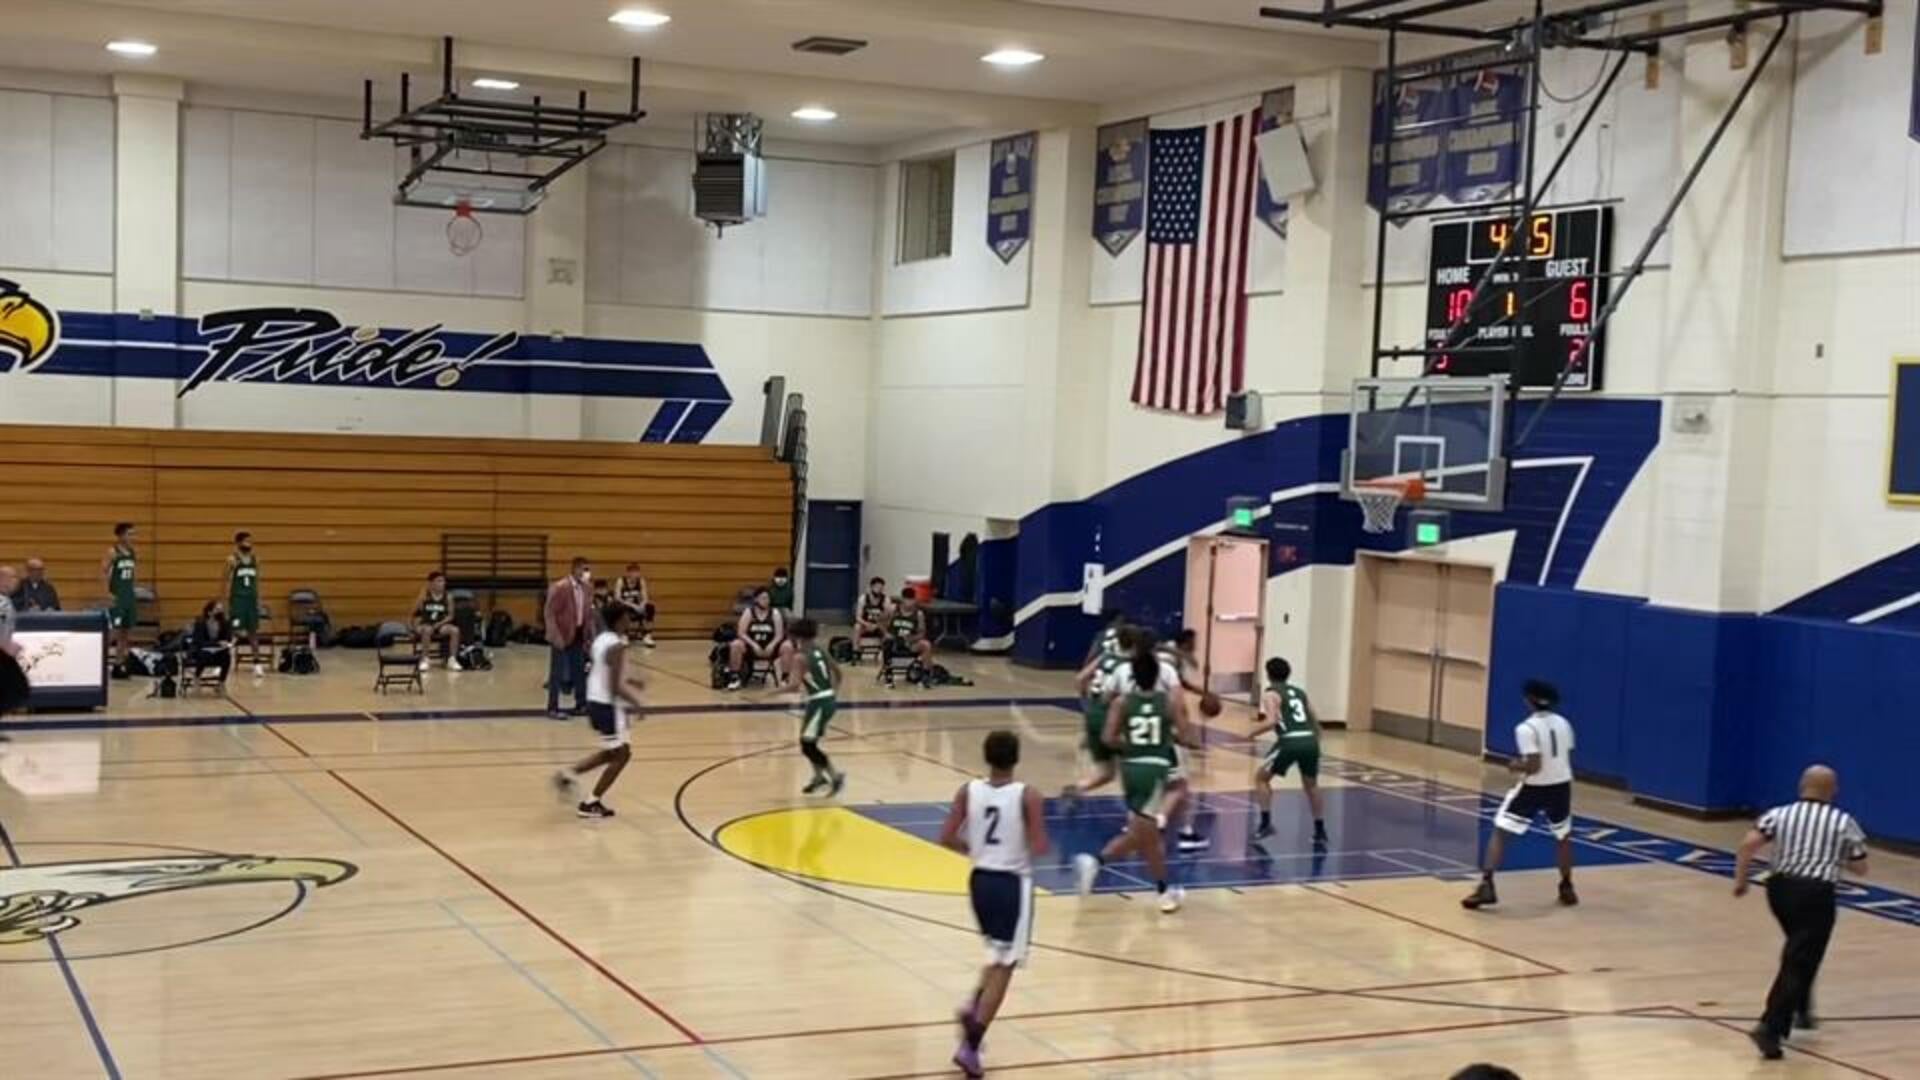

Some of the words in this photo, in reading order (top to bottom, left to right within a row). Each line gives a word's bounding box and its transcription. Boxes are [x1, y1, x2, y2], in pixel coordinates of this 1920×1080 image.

[1437, 266, 1470, 284] HOME
[1545, 257, 1588, 277] GUEST
[1506, 291, 1514, 316] 1
[1570, 282, 1586, 318] 6
[177, 307, 519, 399] Pride!
[1289, 699, 1306, 722] 3
[1129, 716, 1161, 745] 21
[1550, 729, 1557, 757] 1
[985, 807, 1000, 845] 2
